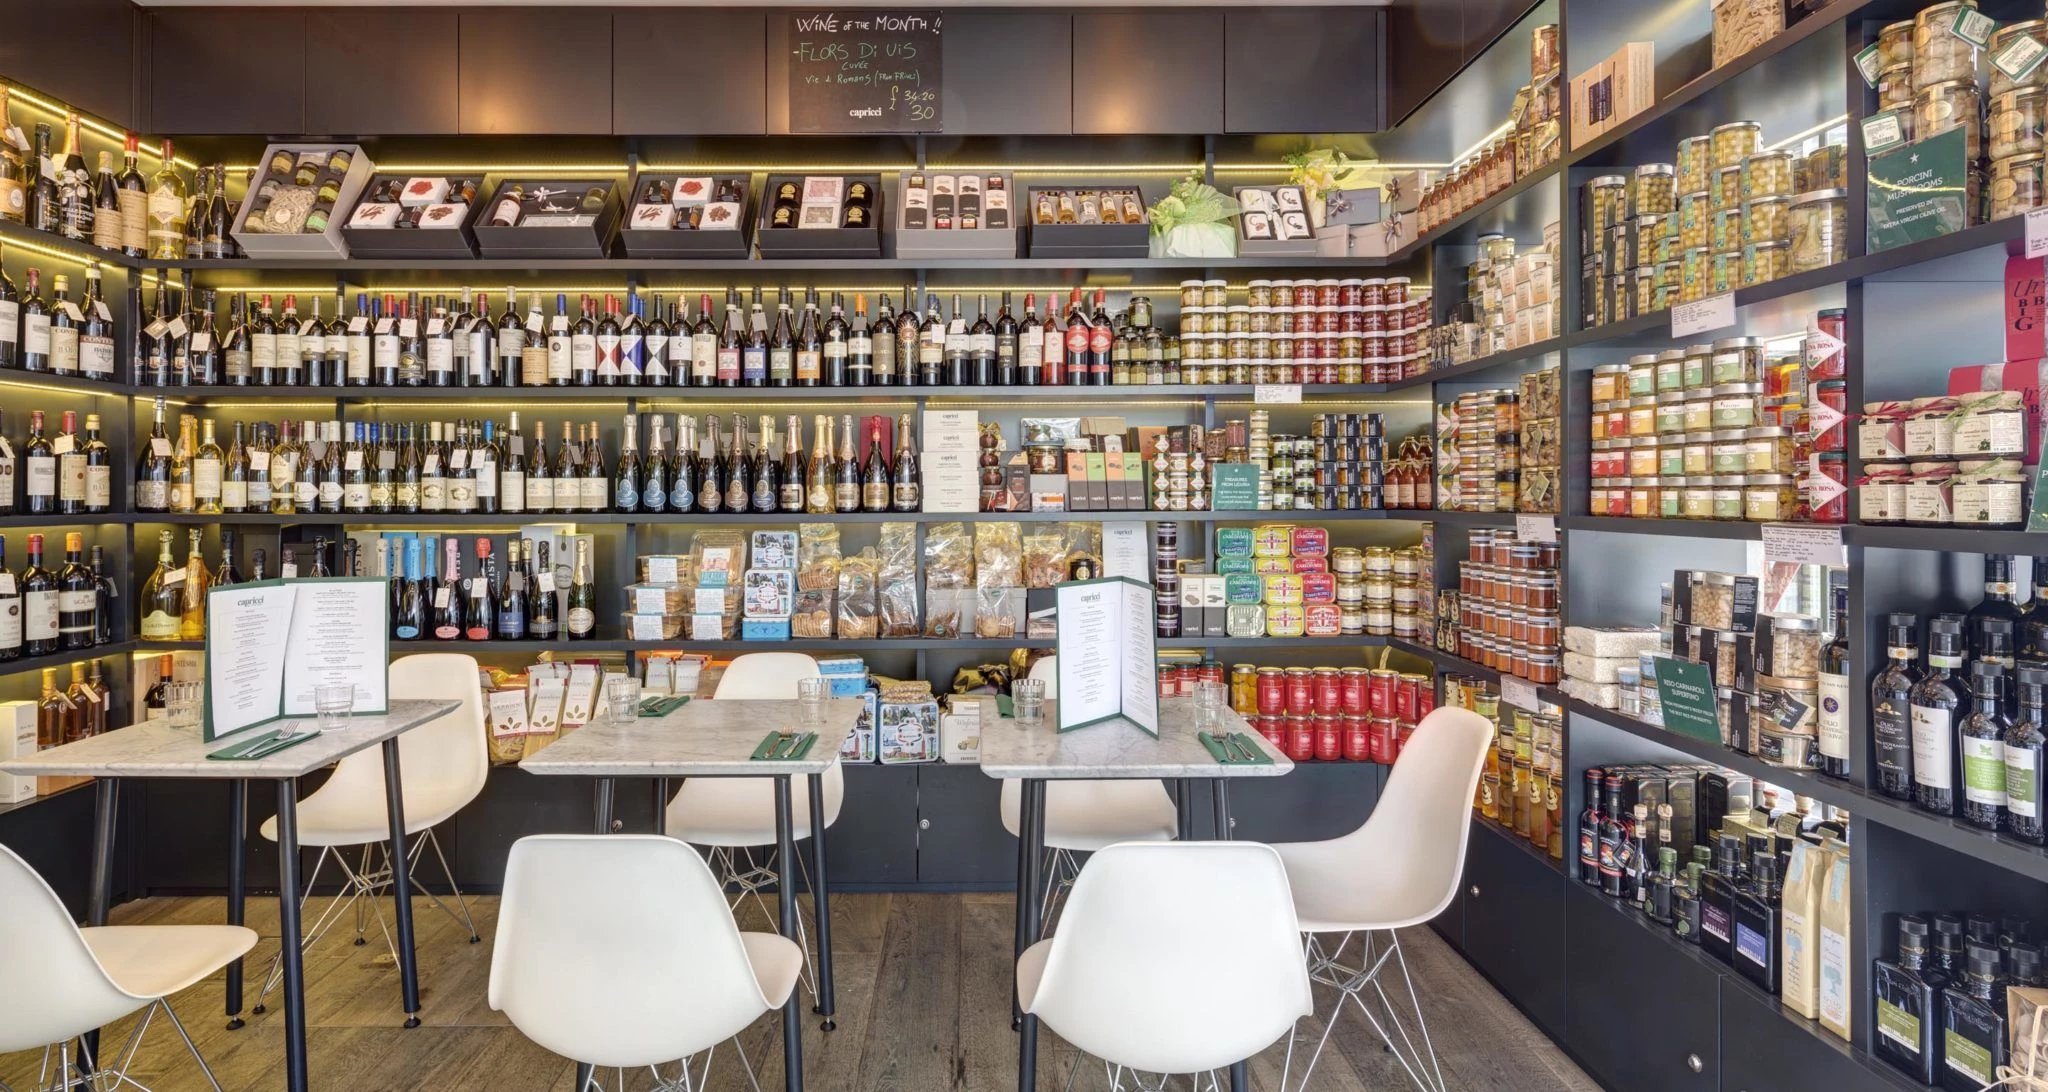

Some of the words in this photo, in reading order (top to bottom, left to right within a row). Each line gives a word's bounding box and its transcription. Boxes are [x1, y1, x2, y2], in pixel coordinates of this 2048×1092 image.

[854, 22, 870, 30] THE
[876, 16, 927, 32] MONTH
[850, 107, 882, 118] capricci
[1896, 169, 1932, 186] PORCINI
[237, 595, 264, 607] capricci
[1081, 592, 1101, 603] capricci
